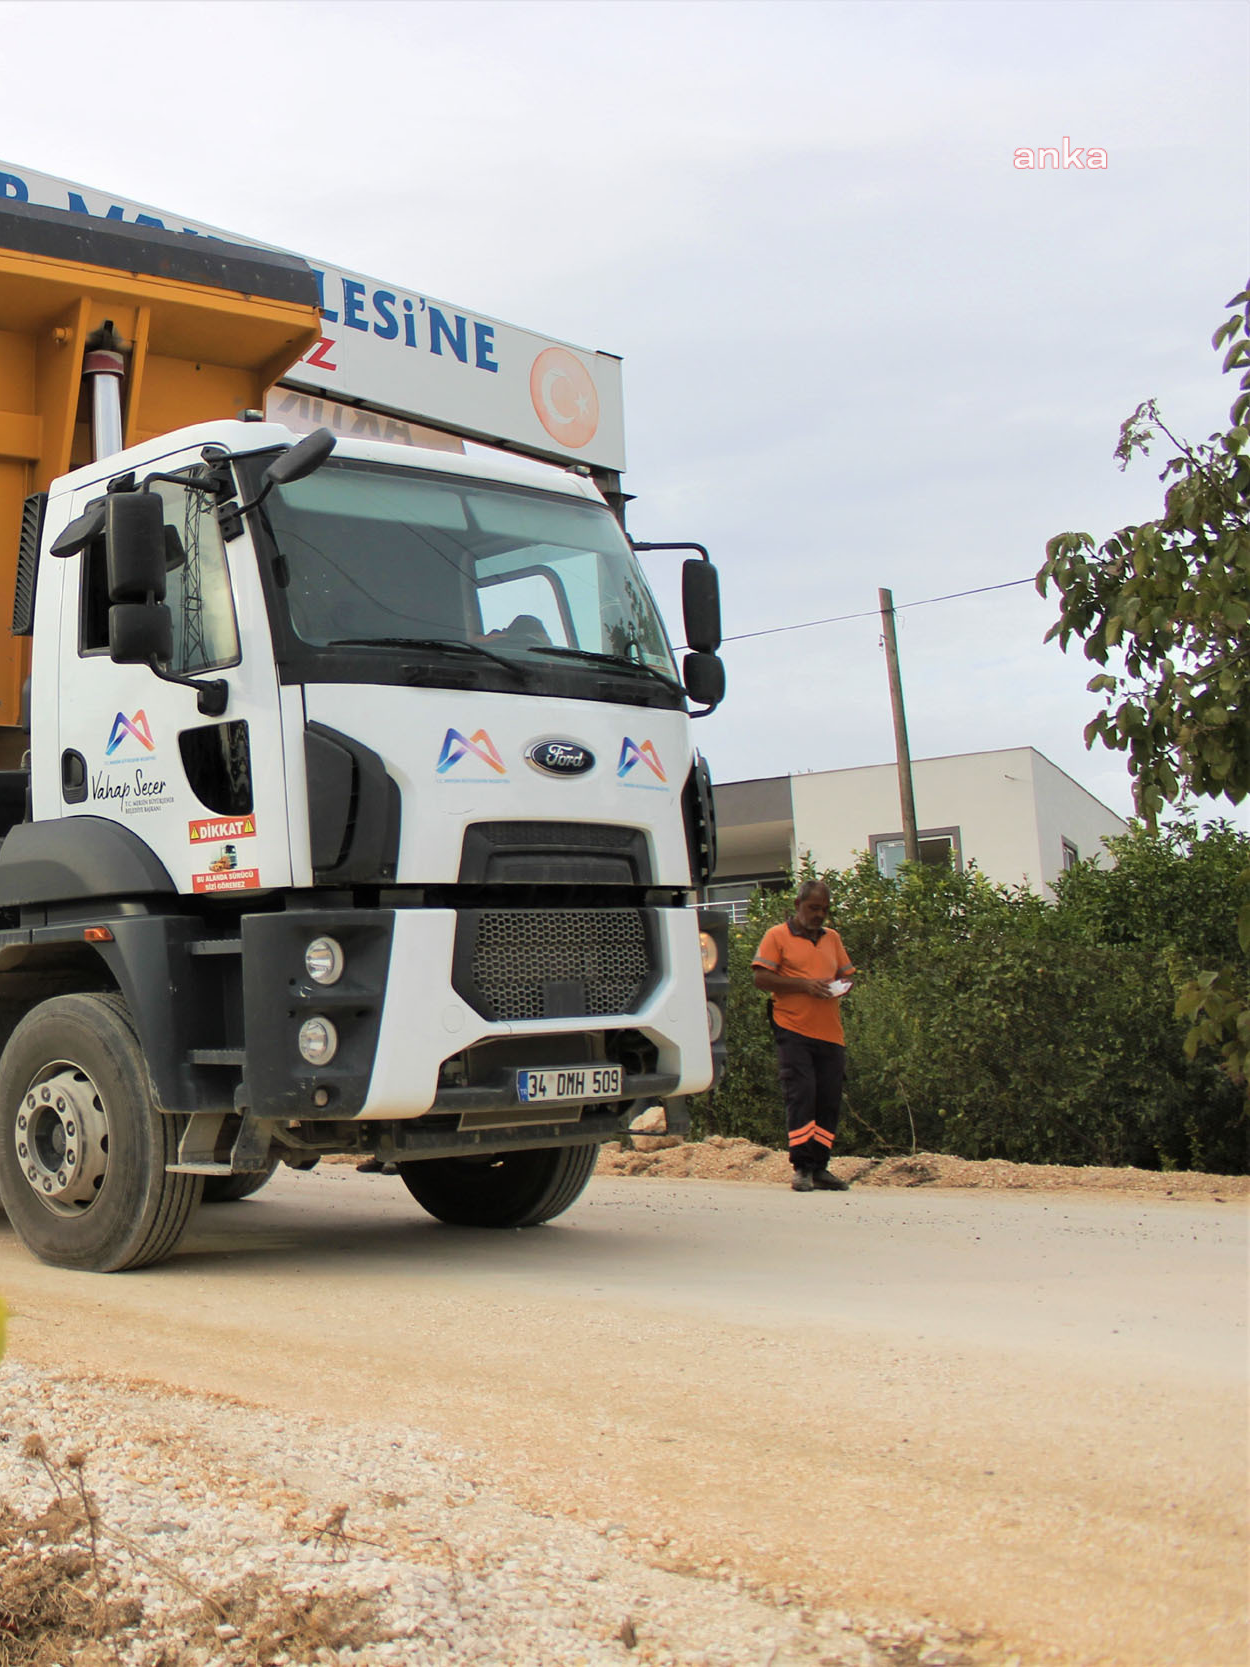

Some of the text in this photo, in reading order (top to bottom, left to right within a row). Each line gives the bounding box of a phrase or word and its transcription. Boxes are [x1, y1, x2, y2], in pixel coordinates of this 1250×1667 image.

[545, 744, 585, 767] Ford
[91, 770, 131, 812] Vahap
[200, 821, 244, 840] DİKKAT
[529, 1074, 546, 1098] 34
[557, 1072, 585, 1096] DMH
[593, 1070, 619, 1094] 509
